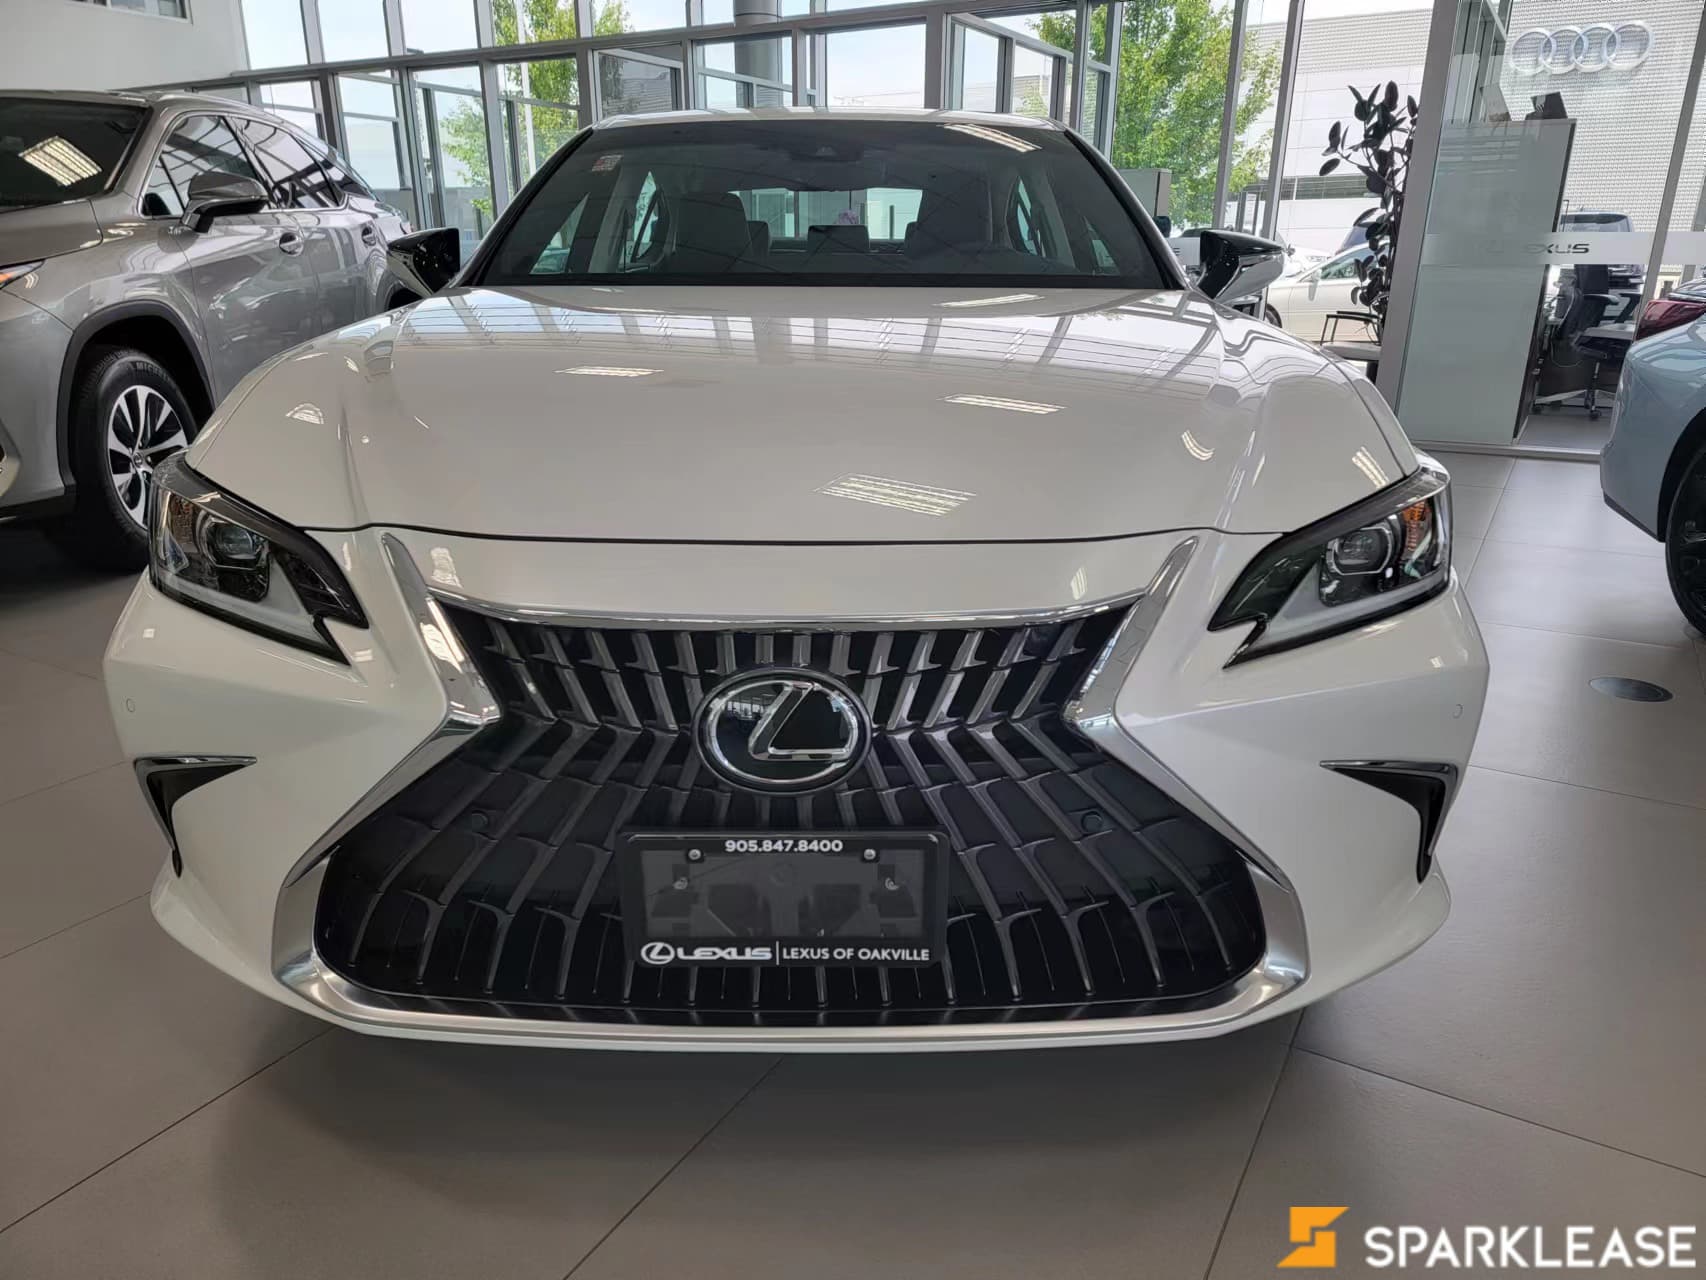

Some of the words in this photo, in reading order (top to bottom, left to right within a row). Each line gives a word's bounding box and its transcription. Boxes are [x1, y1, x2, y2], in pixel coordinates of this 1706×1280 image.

[724, 839, 844, 853] 905.847.8400
[676, 947, 773, 961] LEXUS
[782, 947, 830, 961] LEXUS
[833, 948, 855, 961] OF
[859, 948, 931, 962] OAKVILLE
